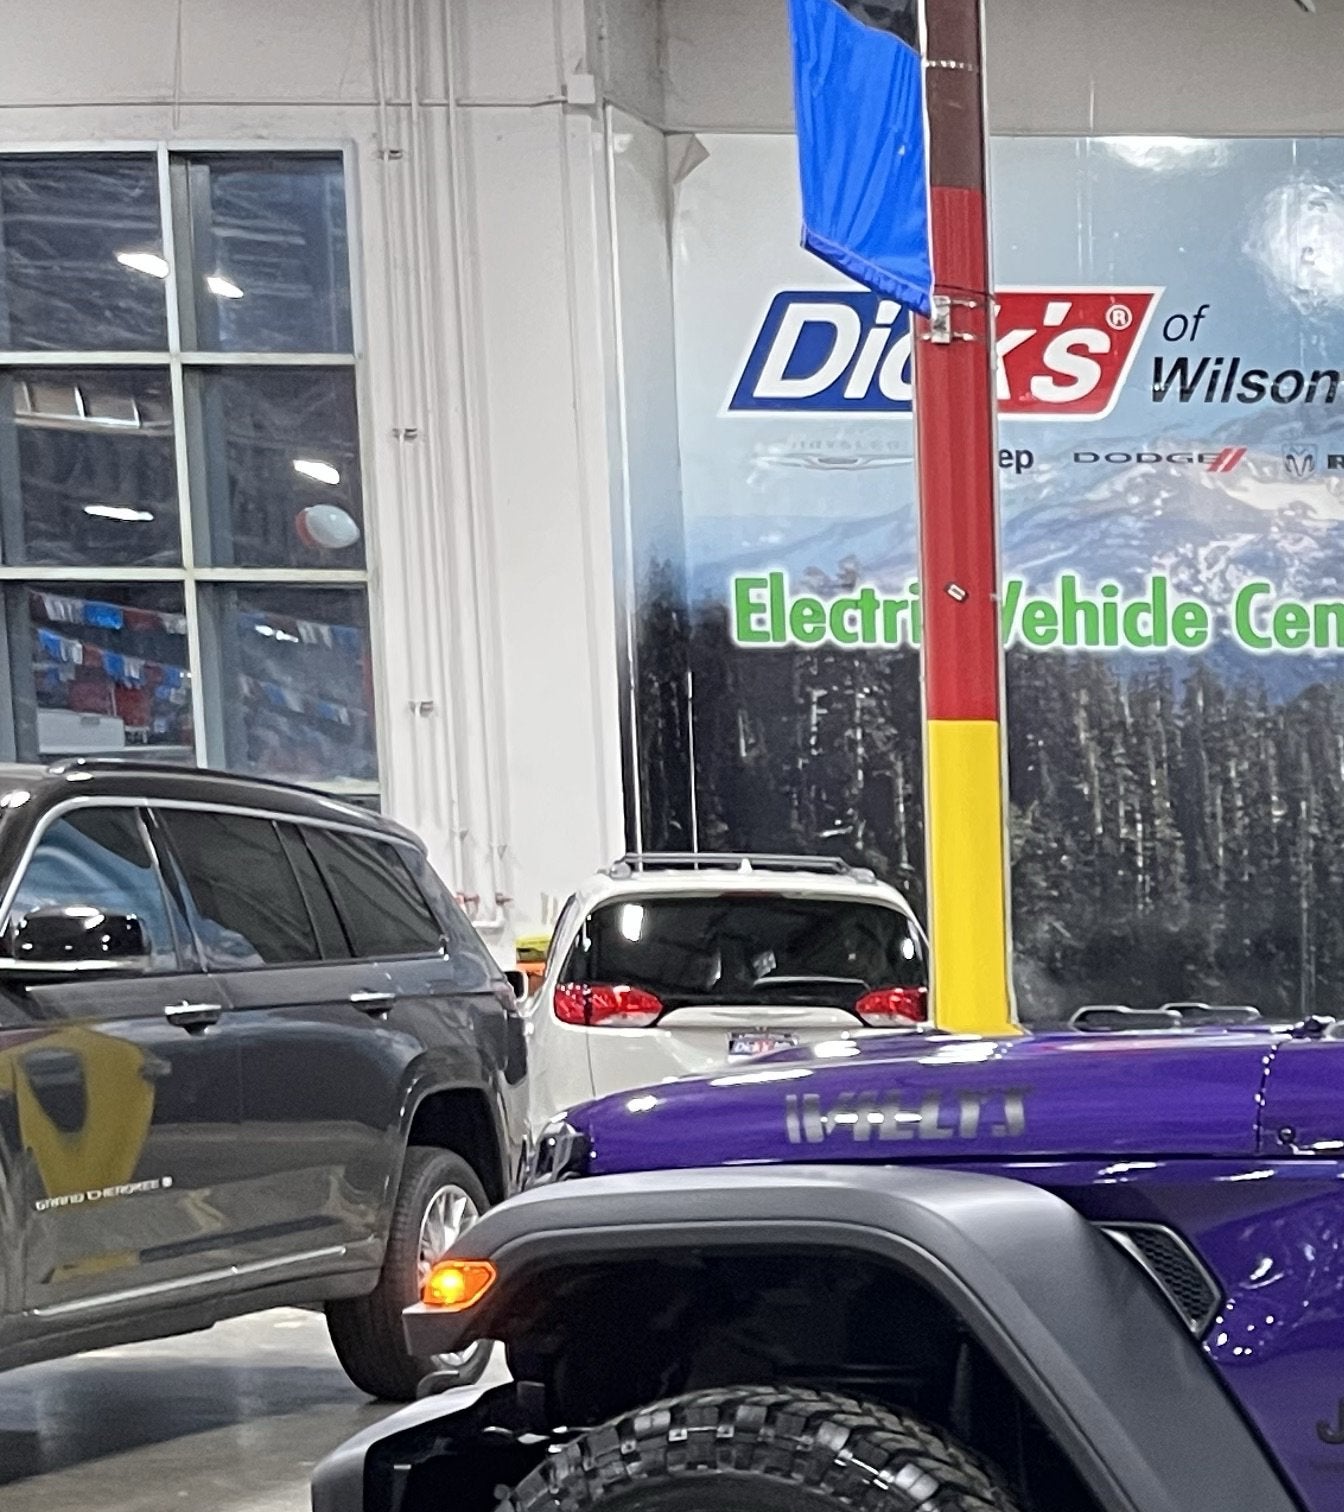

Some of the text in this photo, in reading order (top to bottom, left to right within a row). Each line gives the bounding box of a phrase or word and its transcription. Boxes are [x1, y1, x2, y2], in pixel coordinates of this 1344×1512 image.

[1162, 303, 1210, 342] of
[998, 448, 1034, 474] ep
[1073, 451, 1216, 465] DODGE
[734, 571, 922, 644] Electri
